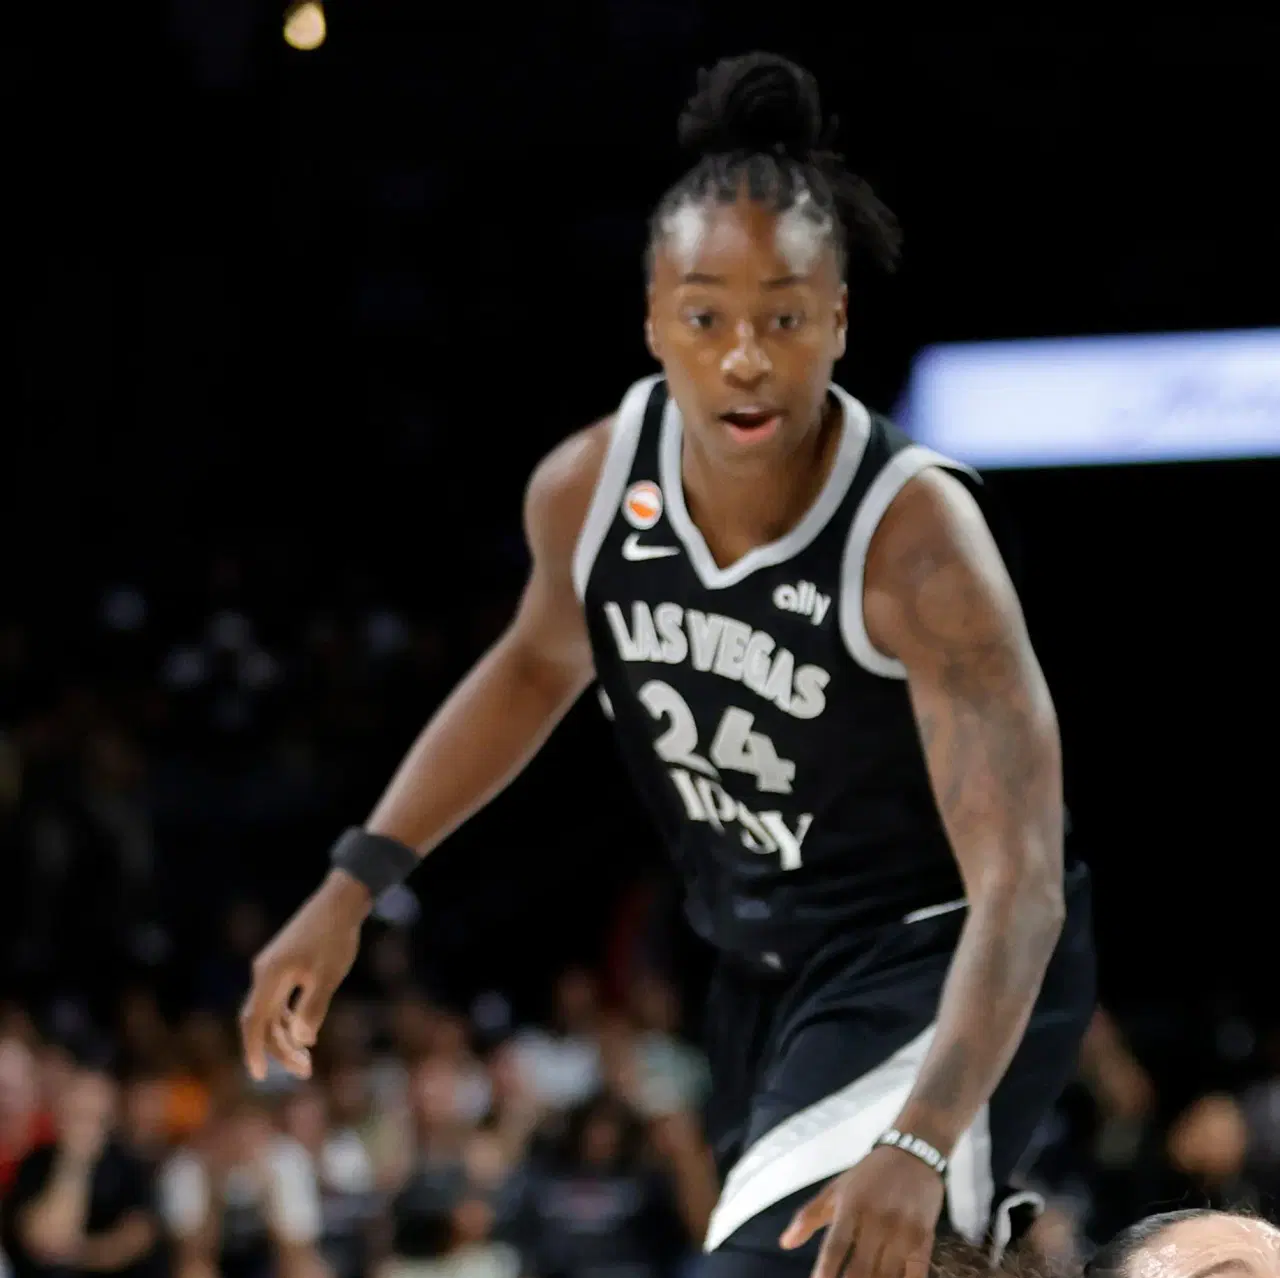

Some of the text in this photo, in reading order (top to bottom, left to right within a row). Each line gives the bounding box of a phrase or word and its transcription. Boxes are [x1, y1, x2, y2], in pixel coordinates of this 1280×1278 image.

[604, 600, 831, 719] LAS VEGAS
[772, 578, 832, 626] ally
[638, 679, 796, 796] 24
